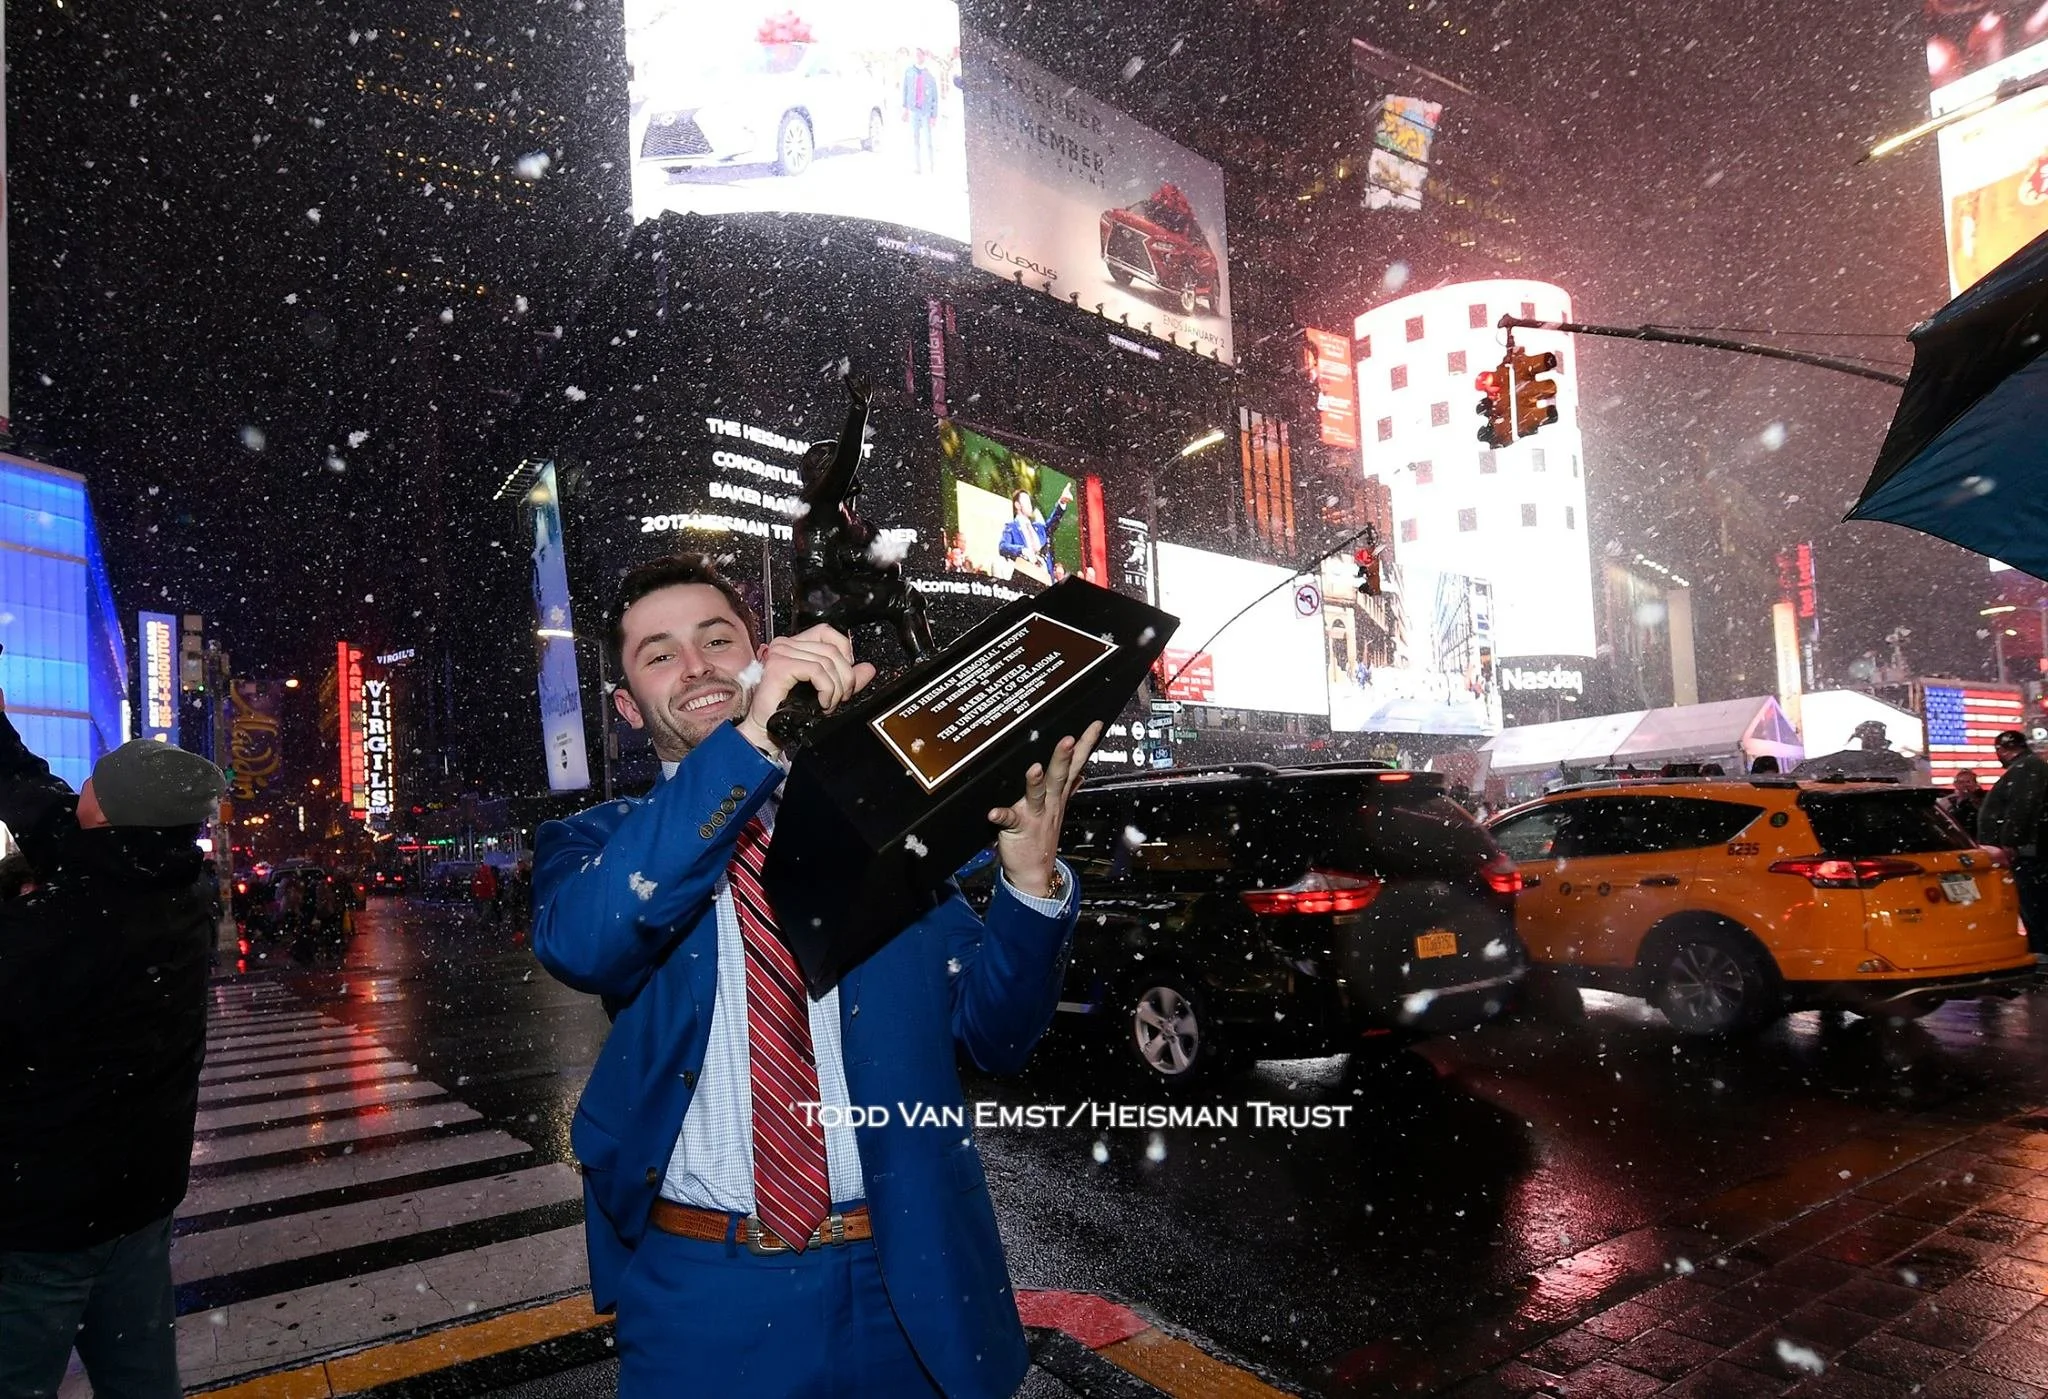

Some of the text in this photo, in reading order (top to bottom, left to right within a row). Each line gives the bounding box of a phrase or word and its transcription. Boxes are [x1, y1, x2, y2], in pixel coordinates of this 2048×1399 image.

[1005, 251, 1058, 281] LEXUS
[1163, 314, 1226, 349] ENDS JANUARY 2
[705, 417, 810, 454] THE HEISMAN
[712, 451, 804, 485] CONGRATUL
[709, 482, 762, 506] BAKER
[641, 513, 690, 532] 2017
[971, 581, 992, 597] the
[376, 648, 415, 664] VIRGIL'S
[898, 626, 1032, 718] THE HEISMAN MEMORIAL TROPHY
[930, 646, 1026, 713] THE HEISMAN TROPHY TRUST
[957, 663, 1028, 713] BAKER MAYFIELD
[1502, 663, 1583, 694] Nasdaq
[936, 650, 1061, 740] THE UNIVERSITY OF OKLAHOMA
[1012, 700, 1032, 714] 2017
[365, 679, 387, 806] VIRGILS
[369, 806, 390, 815] BBQ
